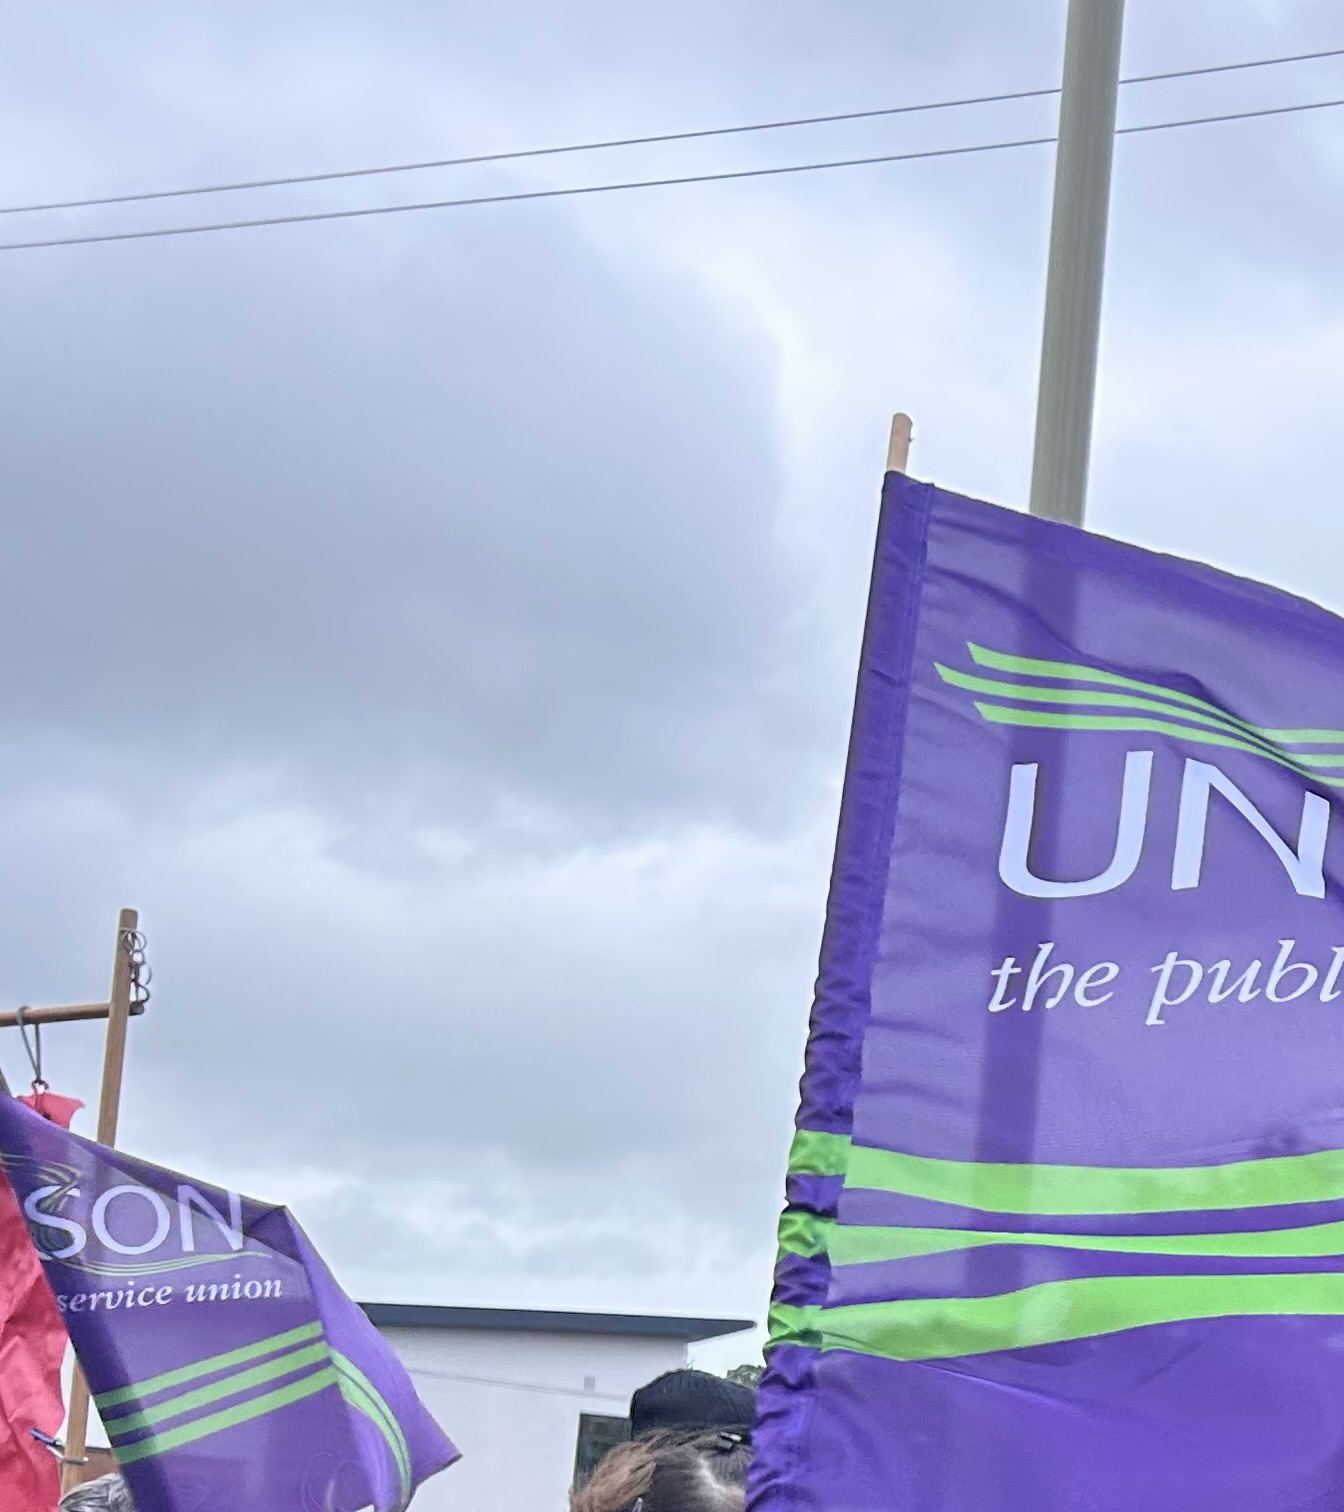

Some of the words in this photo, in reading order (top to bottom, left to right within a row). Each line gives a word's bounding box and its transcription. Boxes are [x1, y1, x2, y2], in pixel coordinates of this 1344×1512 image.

[988, 941, 1120, 1013] the
[24, 1184, 245, 1261] SON
[184, 1273, 282, 1302] union
